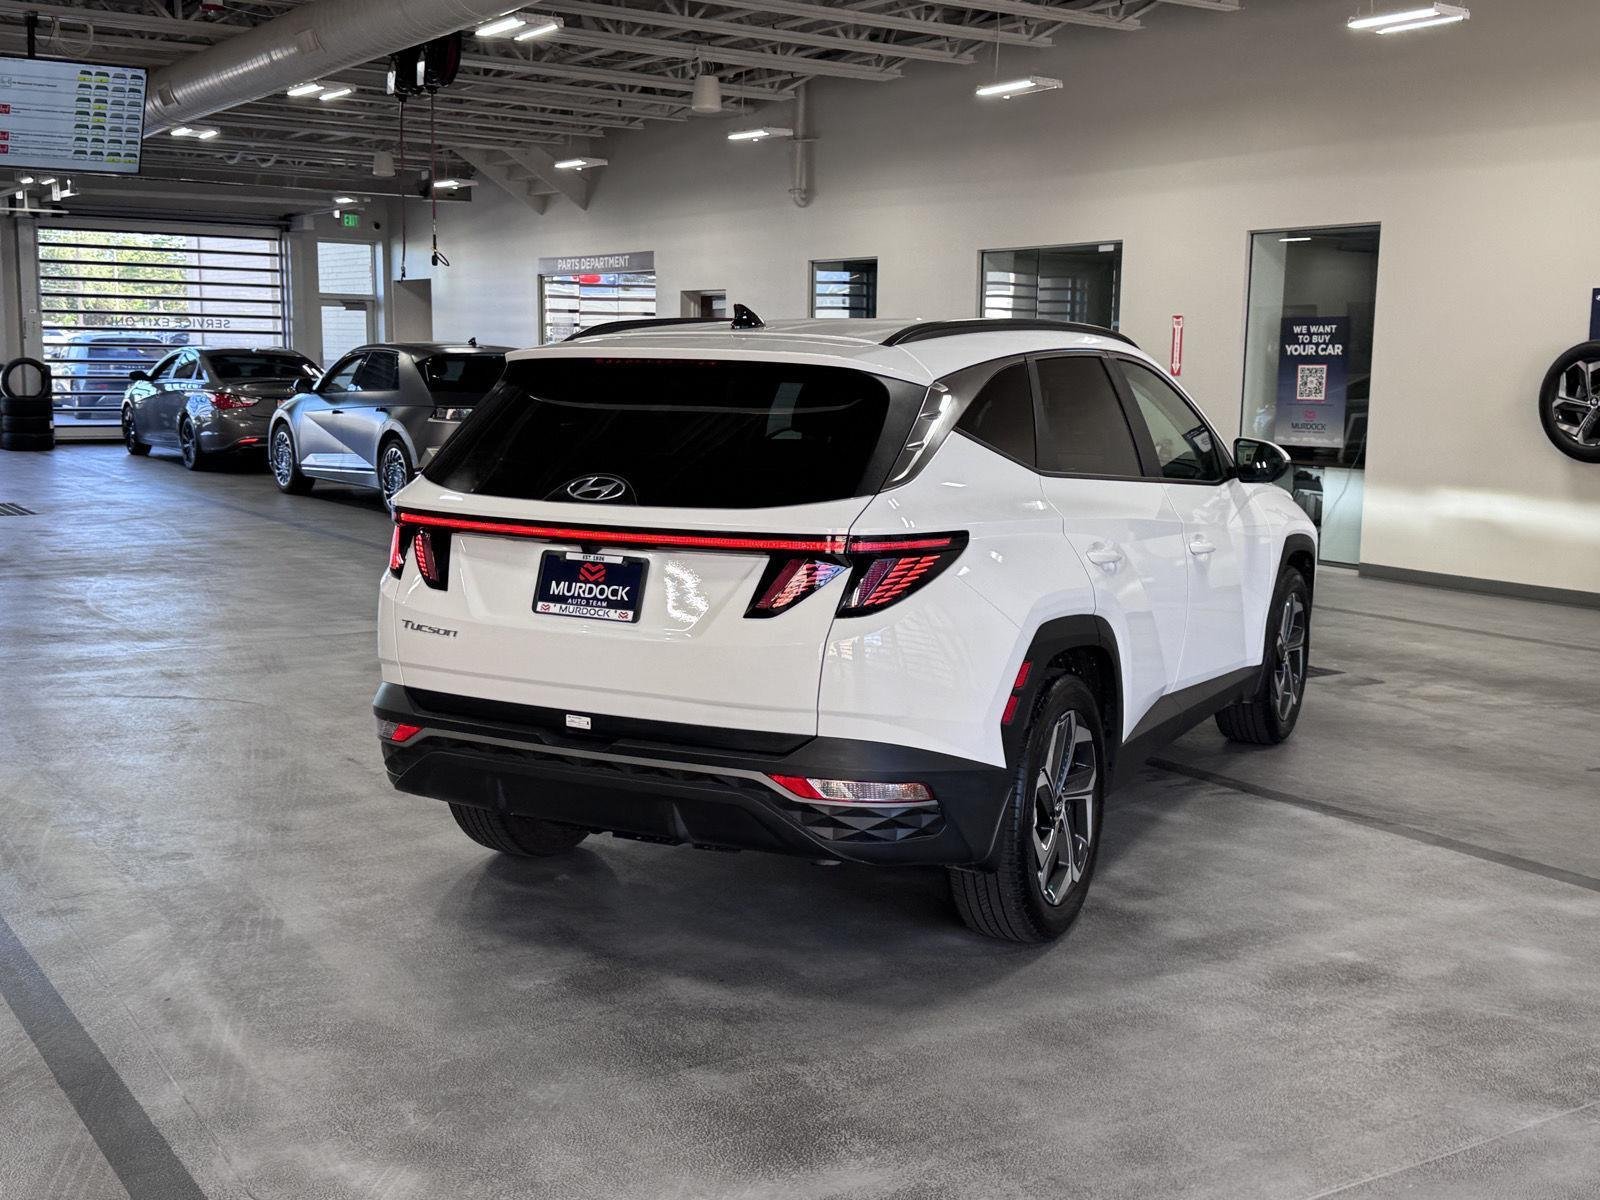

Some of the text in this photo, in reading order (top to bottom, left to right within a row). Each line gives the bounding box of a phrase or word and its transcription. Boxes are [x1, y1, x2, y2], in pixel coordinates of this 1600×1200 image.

[344, 214, 359, 226] EXIT
[557, 255, 630, 270] PARTS DEPARTMENT
[1293, 325, 1337, 333] WE WANT
[1298, 335, 1331, 343] TO BUY
[1285, 345, 1342, 355] YOUR CAR
[550, 580, 630, 601] MURDOCK
[558, 605, 610, 618] MURDOCK
